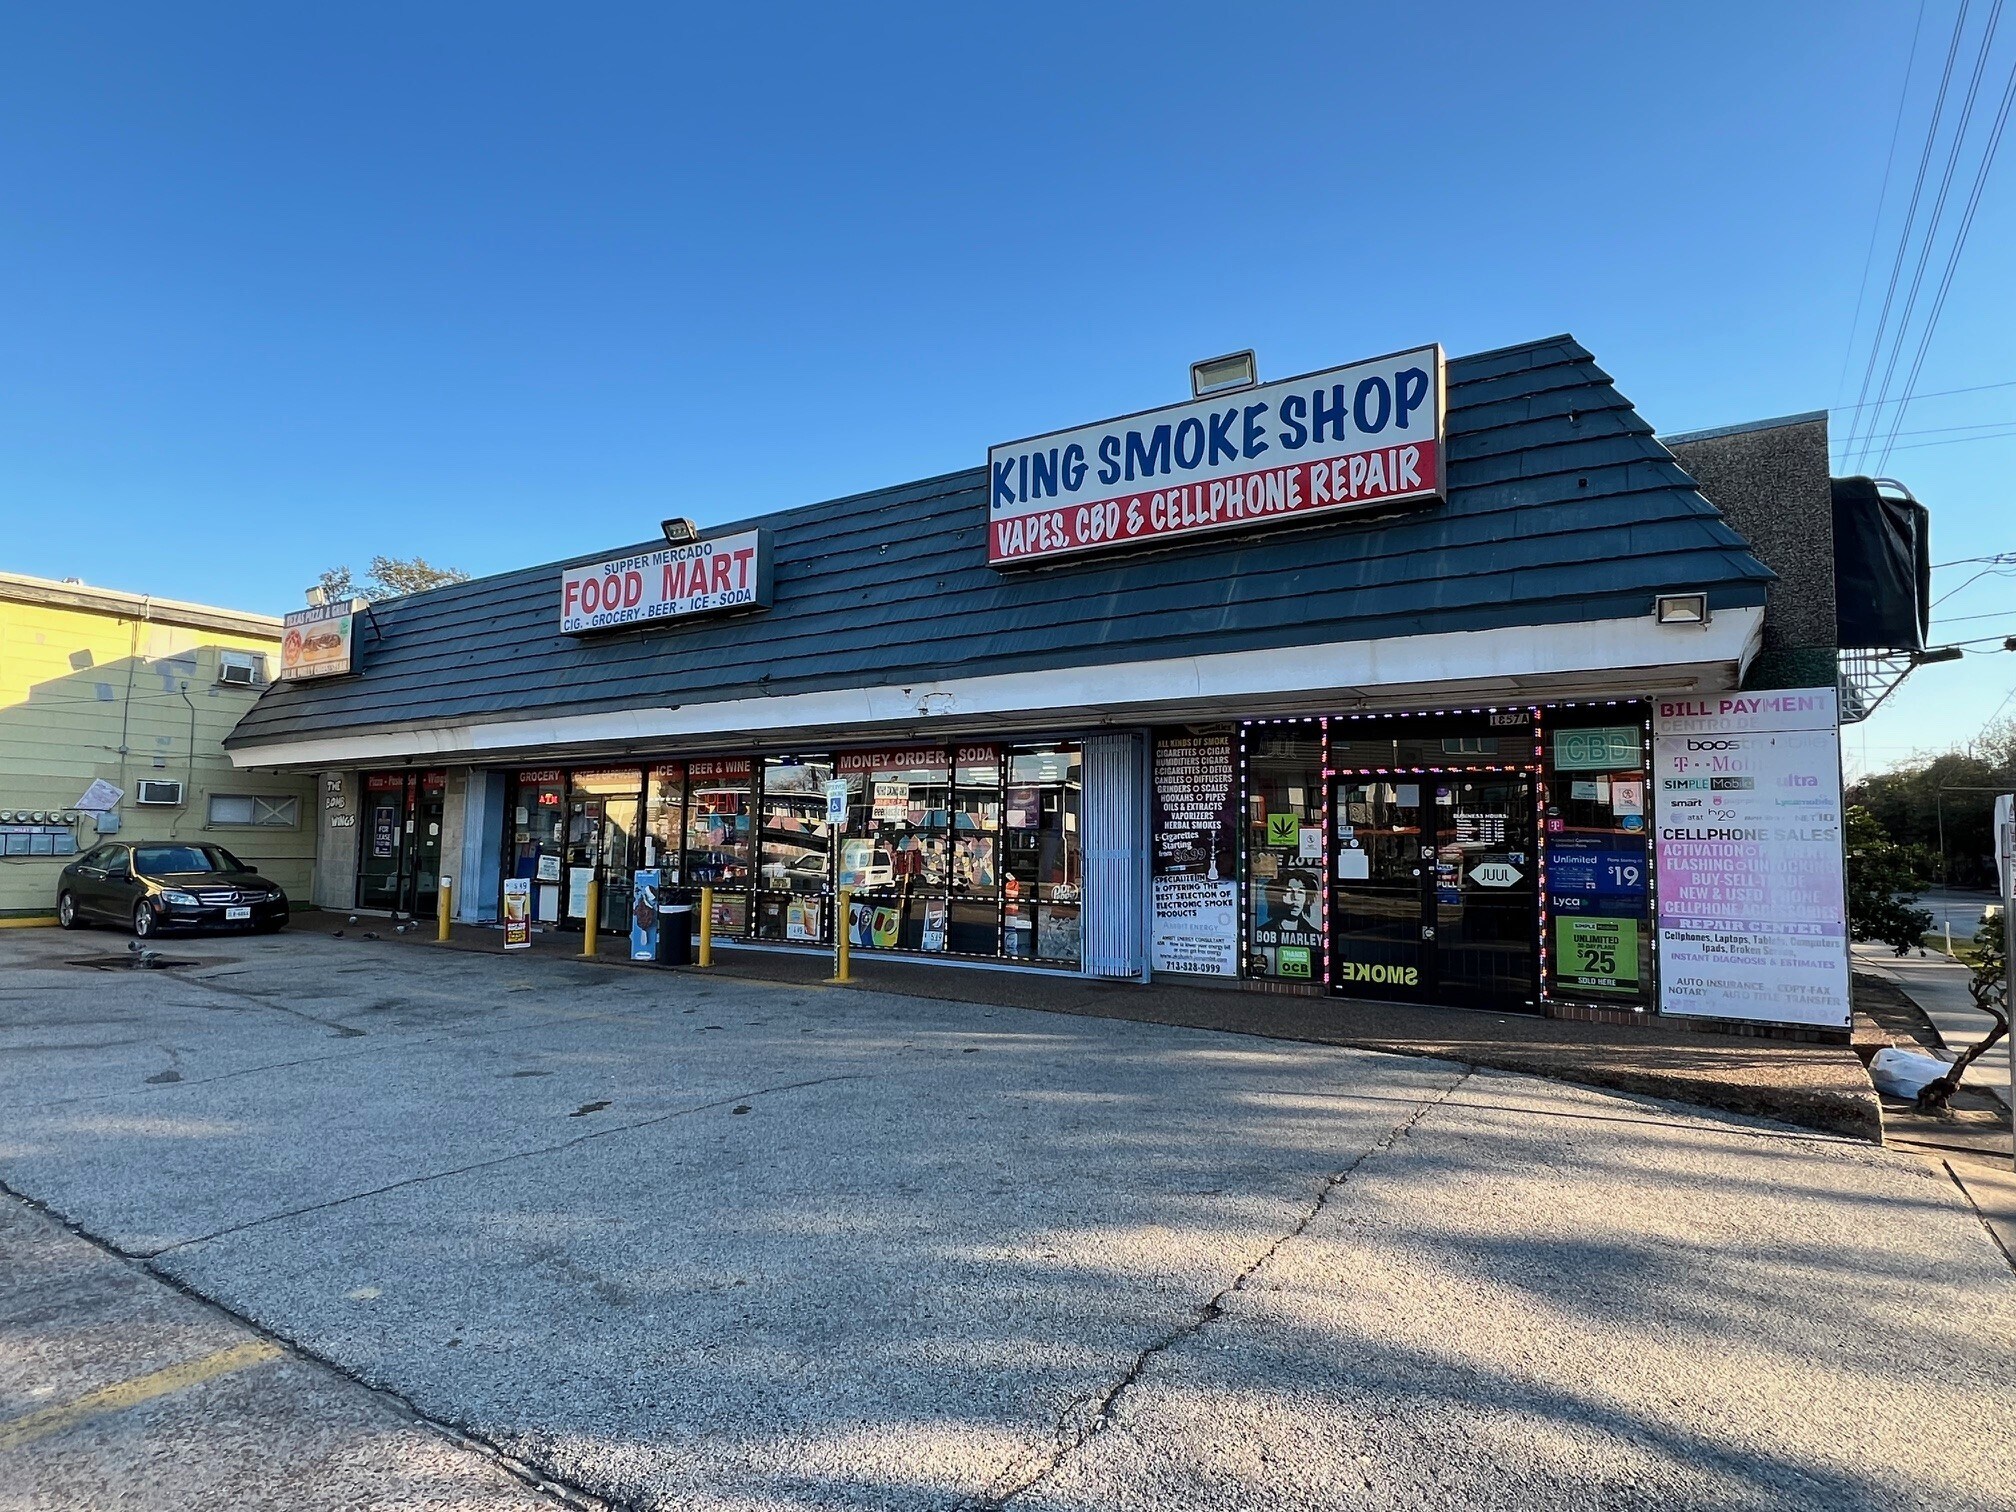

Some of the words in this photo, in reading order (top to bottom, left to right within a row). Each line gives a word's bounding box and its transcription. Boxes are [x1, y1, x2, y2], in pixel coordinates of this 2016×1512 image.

[992, 443, 1089, 509] KING
[1097, 401, 1270, 486] SMOKE
[1278, 366, 1429, 450] SHOP
[997, 512, 1070, 557] VAPES,
[1075, 500, 1121, 544] CBD
[1126, 503, 1145, 536] &
[1149, 466, 1303, 533] CELLPHONE
[1310, 445, 1423, 506] REPAIR
[604, 556, 650, 576] SUPPER
[652, 543, 713, 564] MERCADO
[564, 571, 643, 617] FOOD
[661, 547, 755, 601] MART
[592, 609, 640, 627] GROCERY
[649, 602, 677, 618] BEER
[690, 596, 709, 610] ICE
[719, 588, 752, 606] SODA
[286, 612, 304, 627] TEXAS
[305, 608, 324, 623] PIZZA
[1660, 702, 1712, 718] BILL
[1719, 696, 1827, 714] PAYMENT
[1660, 717, 1731, 732] CENTRO
[1203, 737, 1229, 746] SMOKE
[958, 747, 994, 763] SODA
[1156, 748, 1197, 758] CIGARETTES
[1206, 747, 1231, 756] CIGAR
[1565, 734, 1629, 763] CBD
[840, 752, 891, 770] MONEY
[894, 750, 946, 766] ORDER
[1201, 756, 1229, 765] CIGARS
[656, 765, 674, 777] ICE
[689, 762, 714, 776] BEER
[715, 762, 723, 774] &
[725, 760, 751, 773] WINE
[1209, 765, 1233, 774] DETOX
[519, 770, 561, 783] GROCERY
[1154, 776, 1185, 785] CANDLES
[1193, 774, 1233, 784] DIFFUSERS
[1777, 773, 1818, 788] ultra
[326, 779, 342, 792] THE
[1157, 785, 1191, 794] GRINDERS
[1201, 784, 1229, 792] SCALES
[1664, 780, 1709, 790] SIMPLE
[538, 793, 559, 805] ATM
[1160, 794, 1195, 802] HOOKAHS
[1205, 793, 1226, 802] PIPES
[1671, 799, 1703, 807] smart
[1163, 803, 1179, 811] OILS
[1180, 803, 1186, 811] &
[1186, 802, 1223, 811] EXTRACTS
[330, 814, 356, 828] WINGS
[1171, 811, 1214, 820] VAPORIZERS
[378, 825, 389, 833] FOR
[1164, 821, 1190, 830] HERBAL
[1191, 821, 1222, 829] SMOKES
[1155, 831, 1199, 842] E-Cigarettes
[1663, 828, 1769, 841] CELLPHONE
[1774, 828, 1836, 842] SALES
[1162, 840, 1193, 850] Starting
[1663, 843, 1744, 857] ACTIVATION
[1553, 855, 1598, 864] Unlimited
[1667, 858, 1734, 871] FLASHING
[1481, 868, 1510, 882] JUUL
[1608, 865, 1640, 887] $19
[1162, 883, 1201, 892] OFFERING
[1203, 882, 1219, 890] THE
[1155, 893, 1173, 901] BEST
[1175, 892, 1218, 900] SELECTION
[1219, 890, 1231, 899] OF
[1680, 886, 1708, 900] NEW
[1712, 887, 1722, 901] &
[1726, 888, 1764, 902] USED
[1156, 901, 1202, 910] ELECTRONIC
[1204, 899, 1233, 907] SMOKE
[1553, 896, 1580, 907] Lyca
[1664, 901, 1739, 915] CELLPHONE
[1156, 910, 1197, 918] PRODUCTS
[1679, 918, 1744, 931] REPAIR
[1748, 921, 1823, 935] CENTER
[1256, 930, 1277, 944] BOB
[1280, 931, 1324, 947] MARLEY
[1573, 934, 1620, 945] UNLIMITED
[1282, 950, 1308, 959] THANKS
[1282, 962, 1309, 973] OCB
[1577, 949, 1617, 975] $25
[1671, 953, 1710, 962] INSTANT
[1712, 954, 1767, 966] DIAGNOSIS
[1780, 959, 1836, 970] ESTIMATES
[1577, 976, 1596, 985] SOLD
[1597, 977, 1617, 987] HERE
[1676, 977, 1704, 987] AUTO
[1706, 979, 1765, 991] INSURANCE
[1668, 986, 1708, 997] NOTARY
[1722, 991, 1751, 1000] AUTO
[1786, 994, 1842, 1006] TRANSFER
